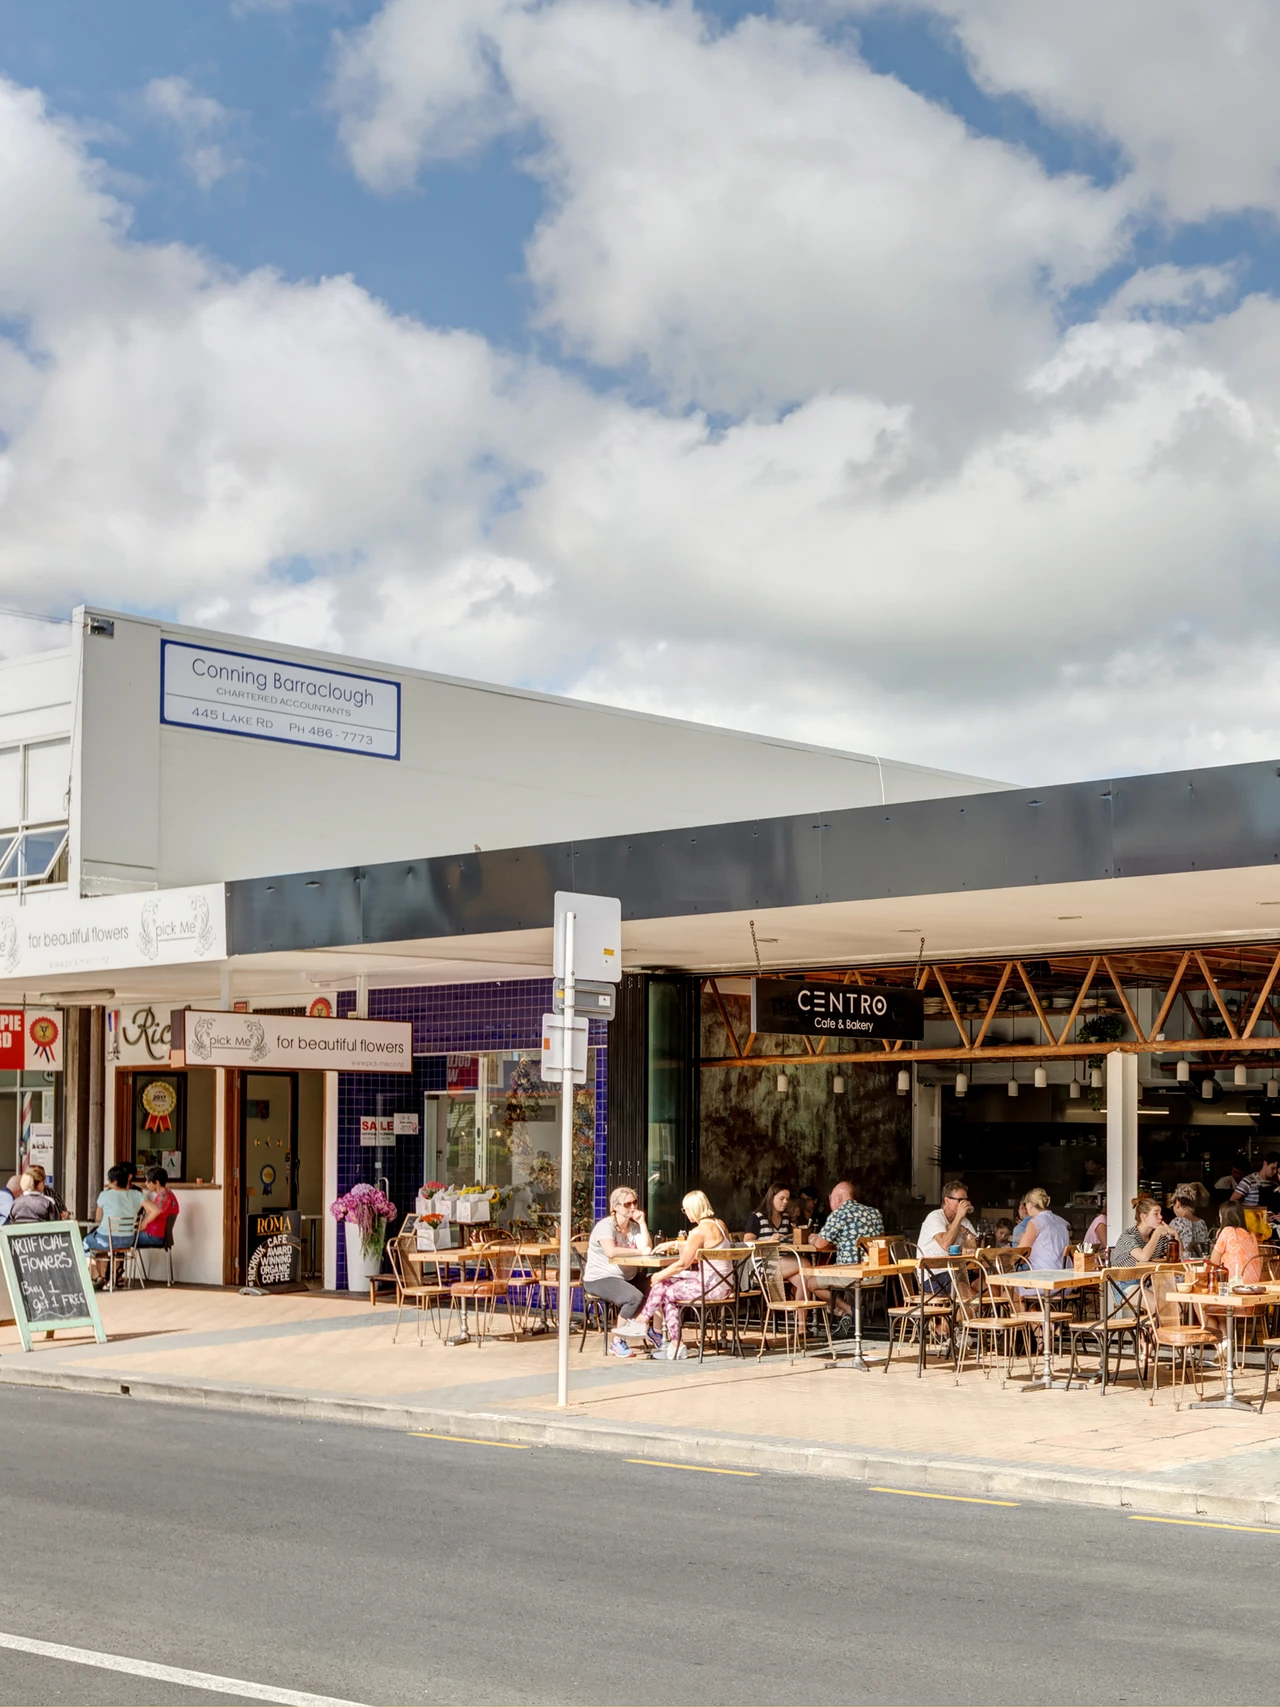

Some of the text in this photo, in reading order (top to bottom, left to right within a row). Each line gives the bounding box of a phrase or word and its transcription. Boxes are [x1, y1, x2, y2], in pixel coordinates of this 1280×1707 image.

[192, 658, 374, 708] Conning Barraclough
[216, 687, 352, 717] CHARTERED ACCOUNTANTS
[191, 707, 219, 720] 445
[222, 711, 253, 726] LAKE
[28, 925, 129, 949] for beautiful flowers
[155, 920, 196, 945] pick Me
[798, 990, 887, 1016] CENTRO
[0, 1014, 22, 1032] PIE
[814, 1017, 874, 1032] Cafe & Bakery
[122, 1006, 171, 1061] Ric
[209, 1035, 251, 1054] pick Me
[276, 1034, 404, 1054] for beautiful flowers
[362, 1121, 394, 1131] SALE
[167, 1158, 176, 1168] A
[257, 1216, 291, 1234] ROMA
[11, 1234, 69, 1256] ARTIFICIAL
[267, 1234, 288, 1247] CAFE
[260, 1254, 292, 1266] WINNING
[266, 1245, 293, 1257] AWARD
[260, 1263, 290, 1275] ORGANIC
[21, 1280, 60, 1300] Buy 1
[33, 1292, 86, 1314] get 1 FREE
